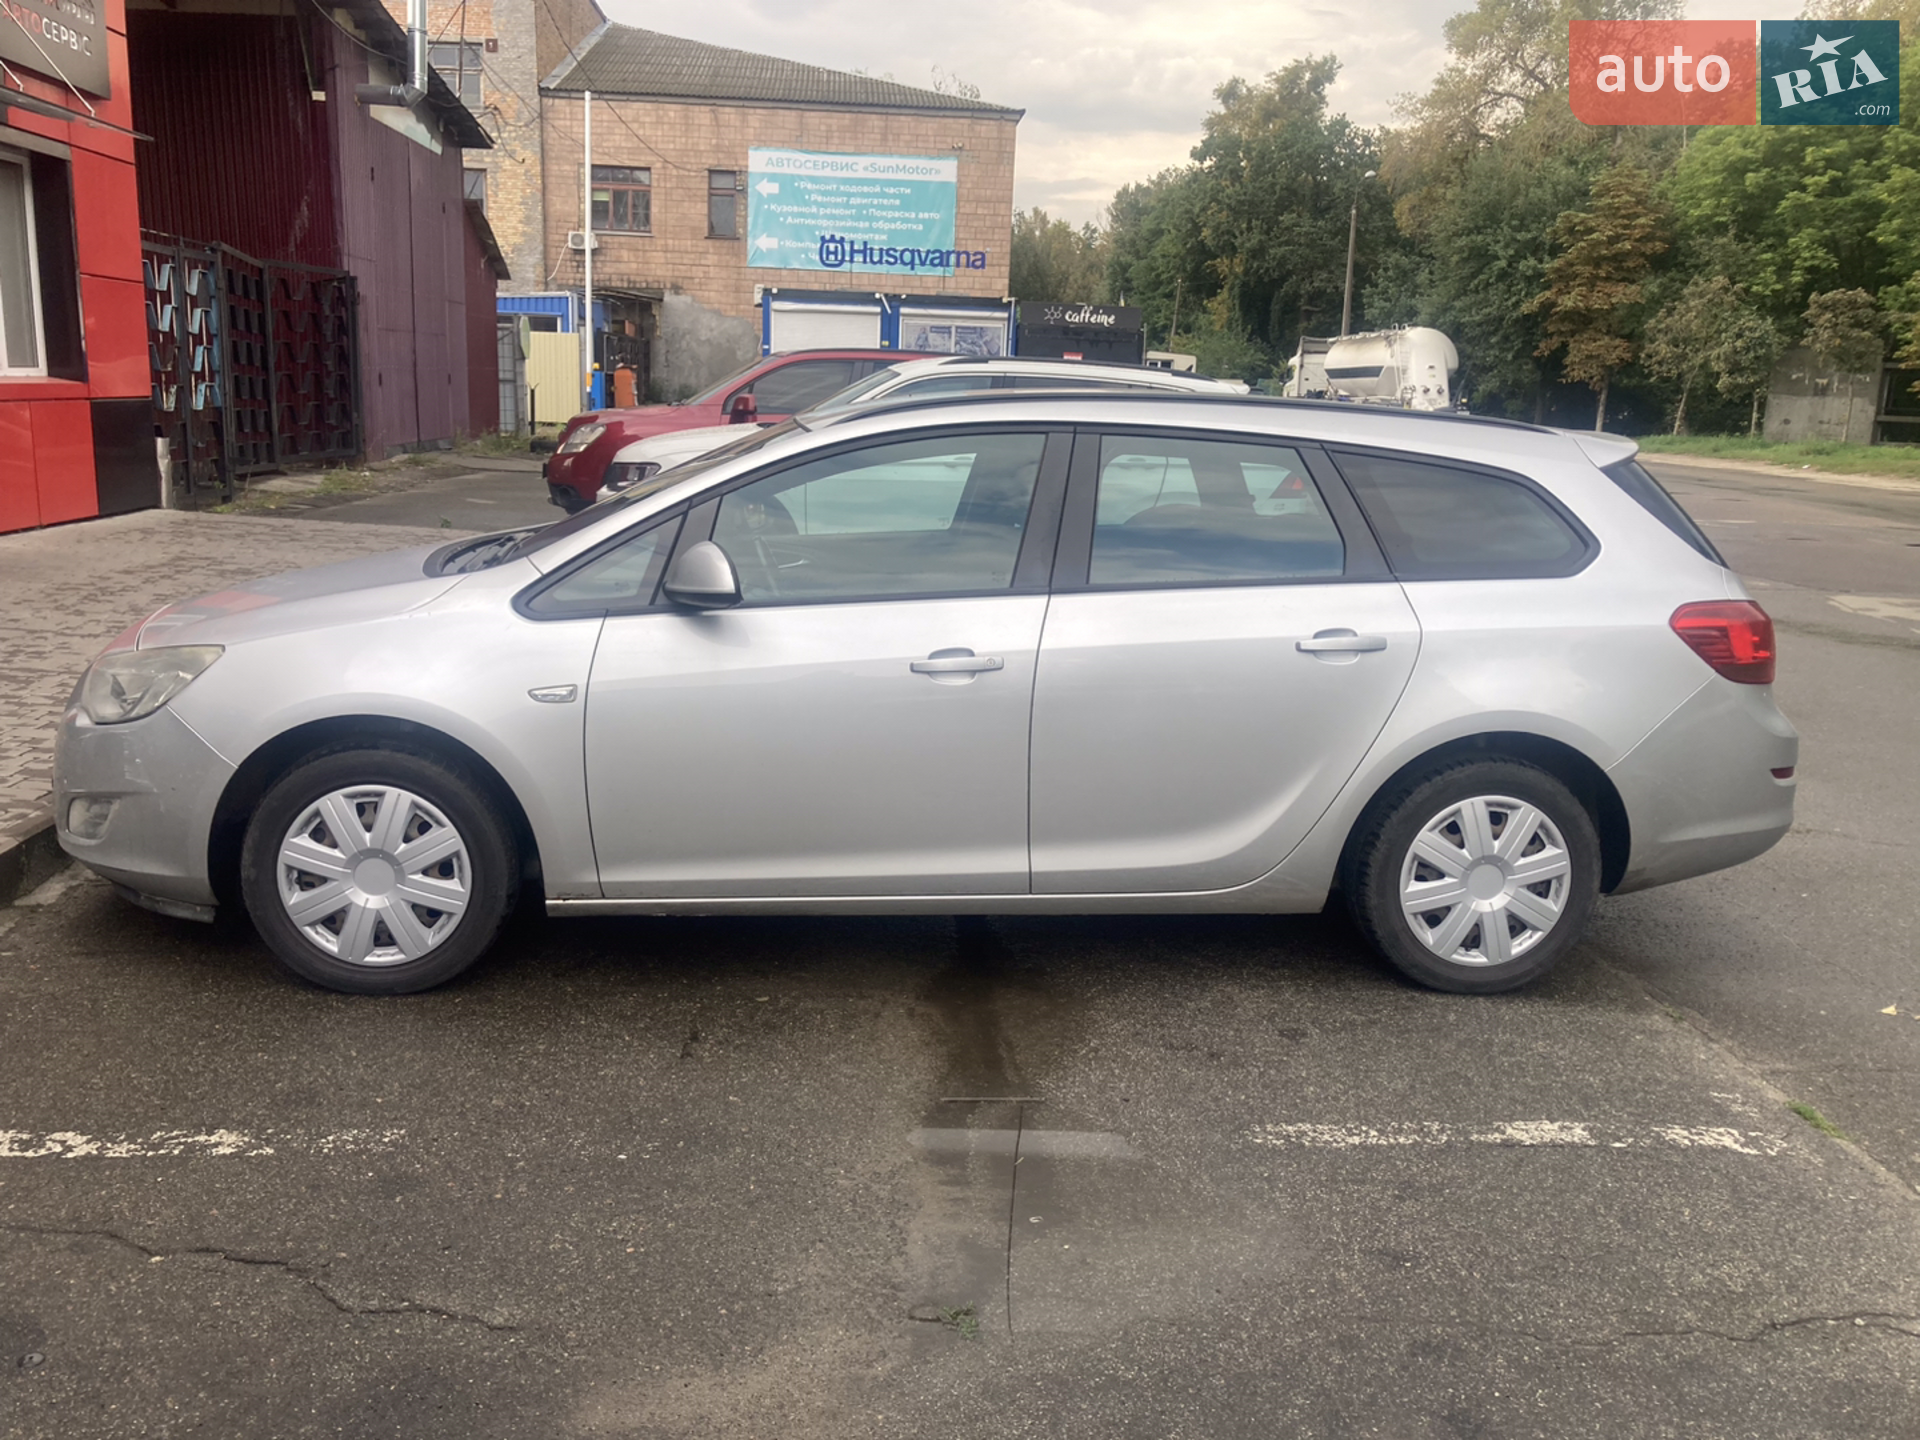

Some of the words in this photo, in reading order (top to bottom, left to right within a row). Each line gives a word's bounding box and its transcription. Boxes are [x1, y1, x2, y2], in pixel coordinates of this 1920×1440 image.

[765, 157, 859, 172] АВТОСЕРВИС
[862, 162, 941, 176] «SunMotor»
[800, 181, 837, 191] Ремонт
[839, 184, 881, 193] ходовой
[883, 186, 912, 194] части
[810, 194, 847, 203] Ремонт
[849, 196, 900, 206] двигателя
[770, 203, 817, 213] Кузовной
[820, 206, 856, 215] ремонт
[868, 208, 916, 219] Покраска
[918, 212, 940, 220] авто
[871, 220, 924, 231] обработка
[849, 240, 986, 271] Husqvarna
[1065, 305, 1116, 328] caffeine
